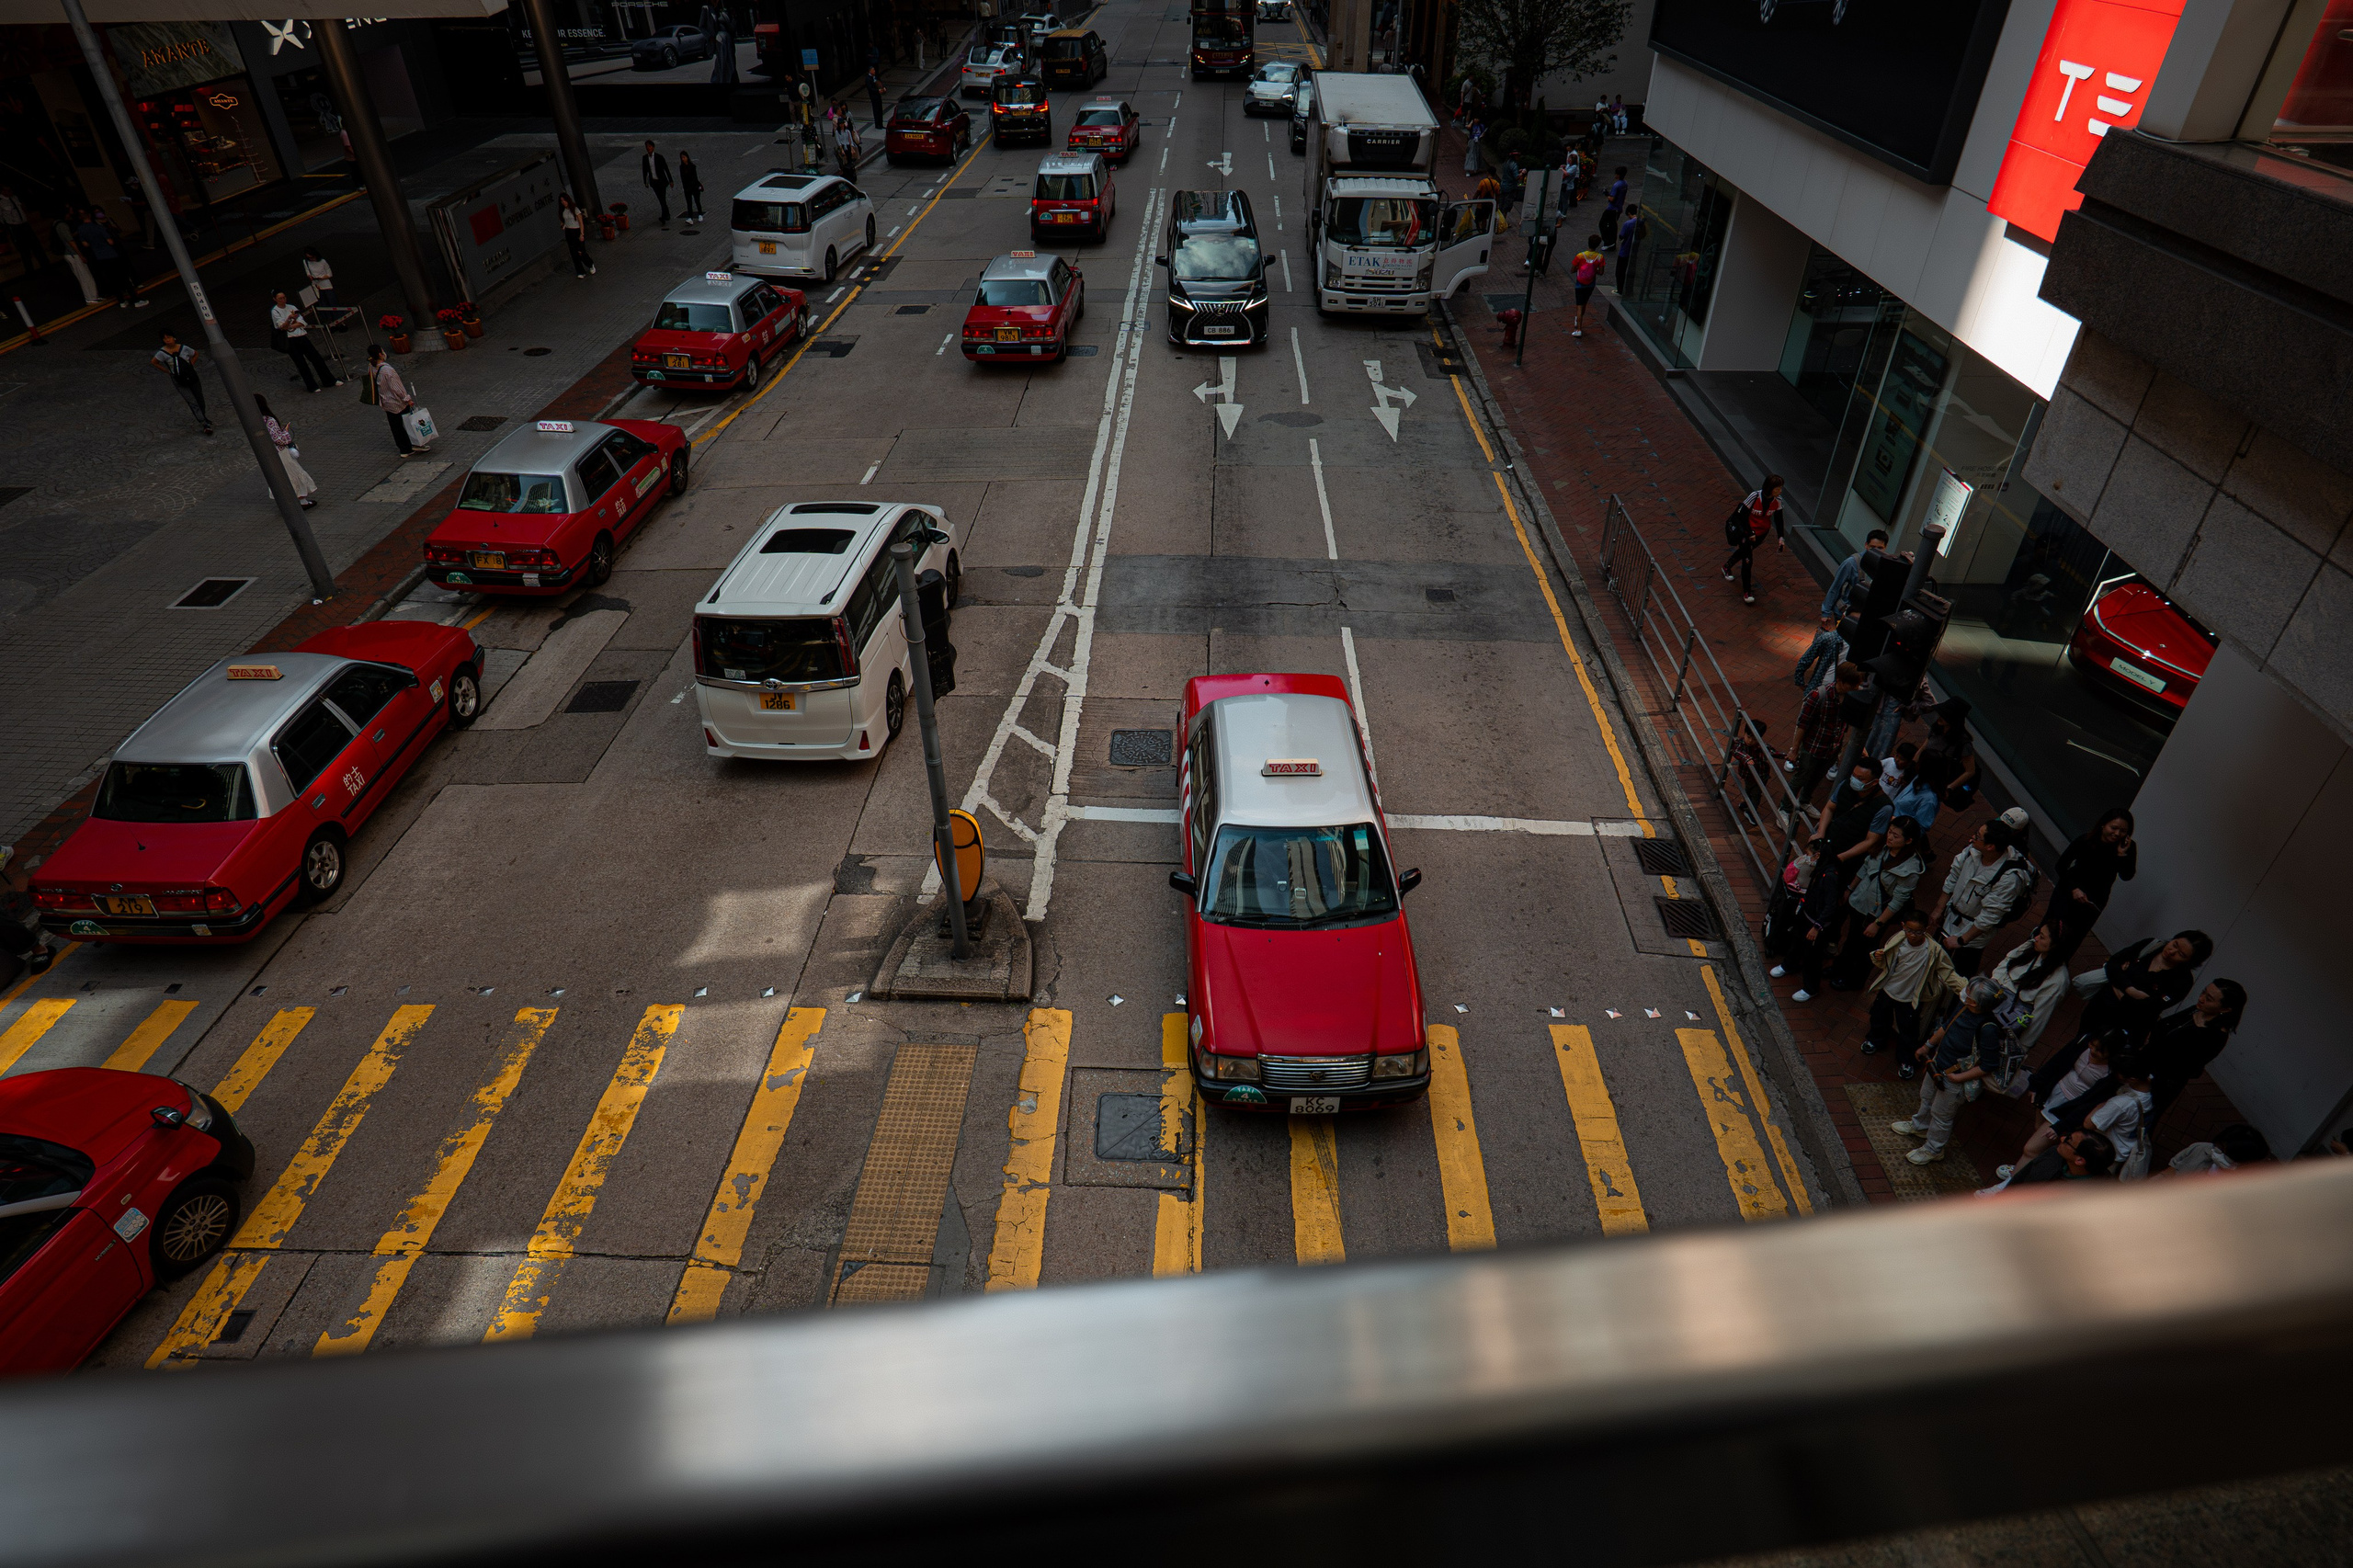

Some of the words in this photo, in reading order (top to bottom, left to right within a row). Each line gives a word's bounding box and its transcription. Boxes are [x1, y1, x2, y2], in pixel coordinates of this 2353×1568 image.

[567, 28, 607, 38] ESSENCE.
[141, 38, 211, 68] AMANTE
[504, 205, 534, 229] HOPEWELL
[534, 192, 554, 211] CENTRE
[1348, 256, 1381, 267] ETAK
[193, 285, 210, 318] 50406
[539, 422, 569, 431] TAXI
[476, 556, 489, 564] FX
[494, 556, 503, 564] 18
[229, 668, 273, 678] TAXI
[2118, 664, 2147, 682] MODEL
[770, 693, 783, 701] JV
[765, 700, 790, 710] 1286
[1268, 764, 1318, 773] TAXI
[343, 765, 360, 787] 的士
[347, 774, 366, 797] TAXI
[117, 903, 144, 915] 219
[1305, 1096, 1324, 1105] KC
[1294, 1104, 1336, 1113] 8069
